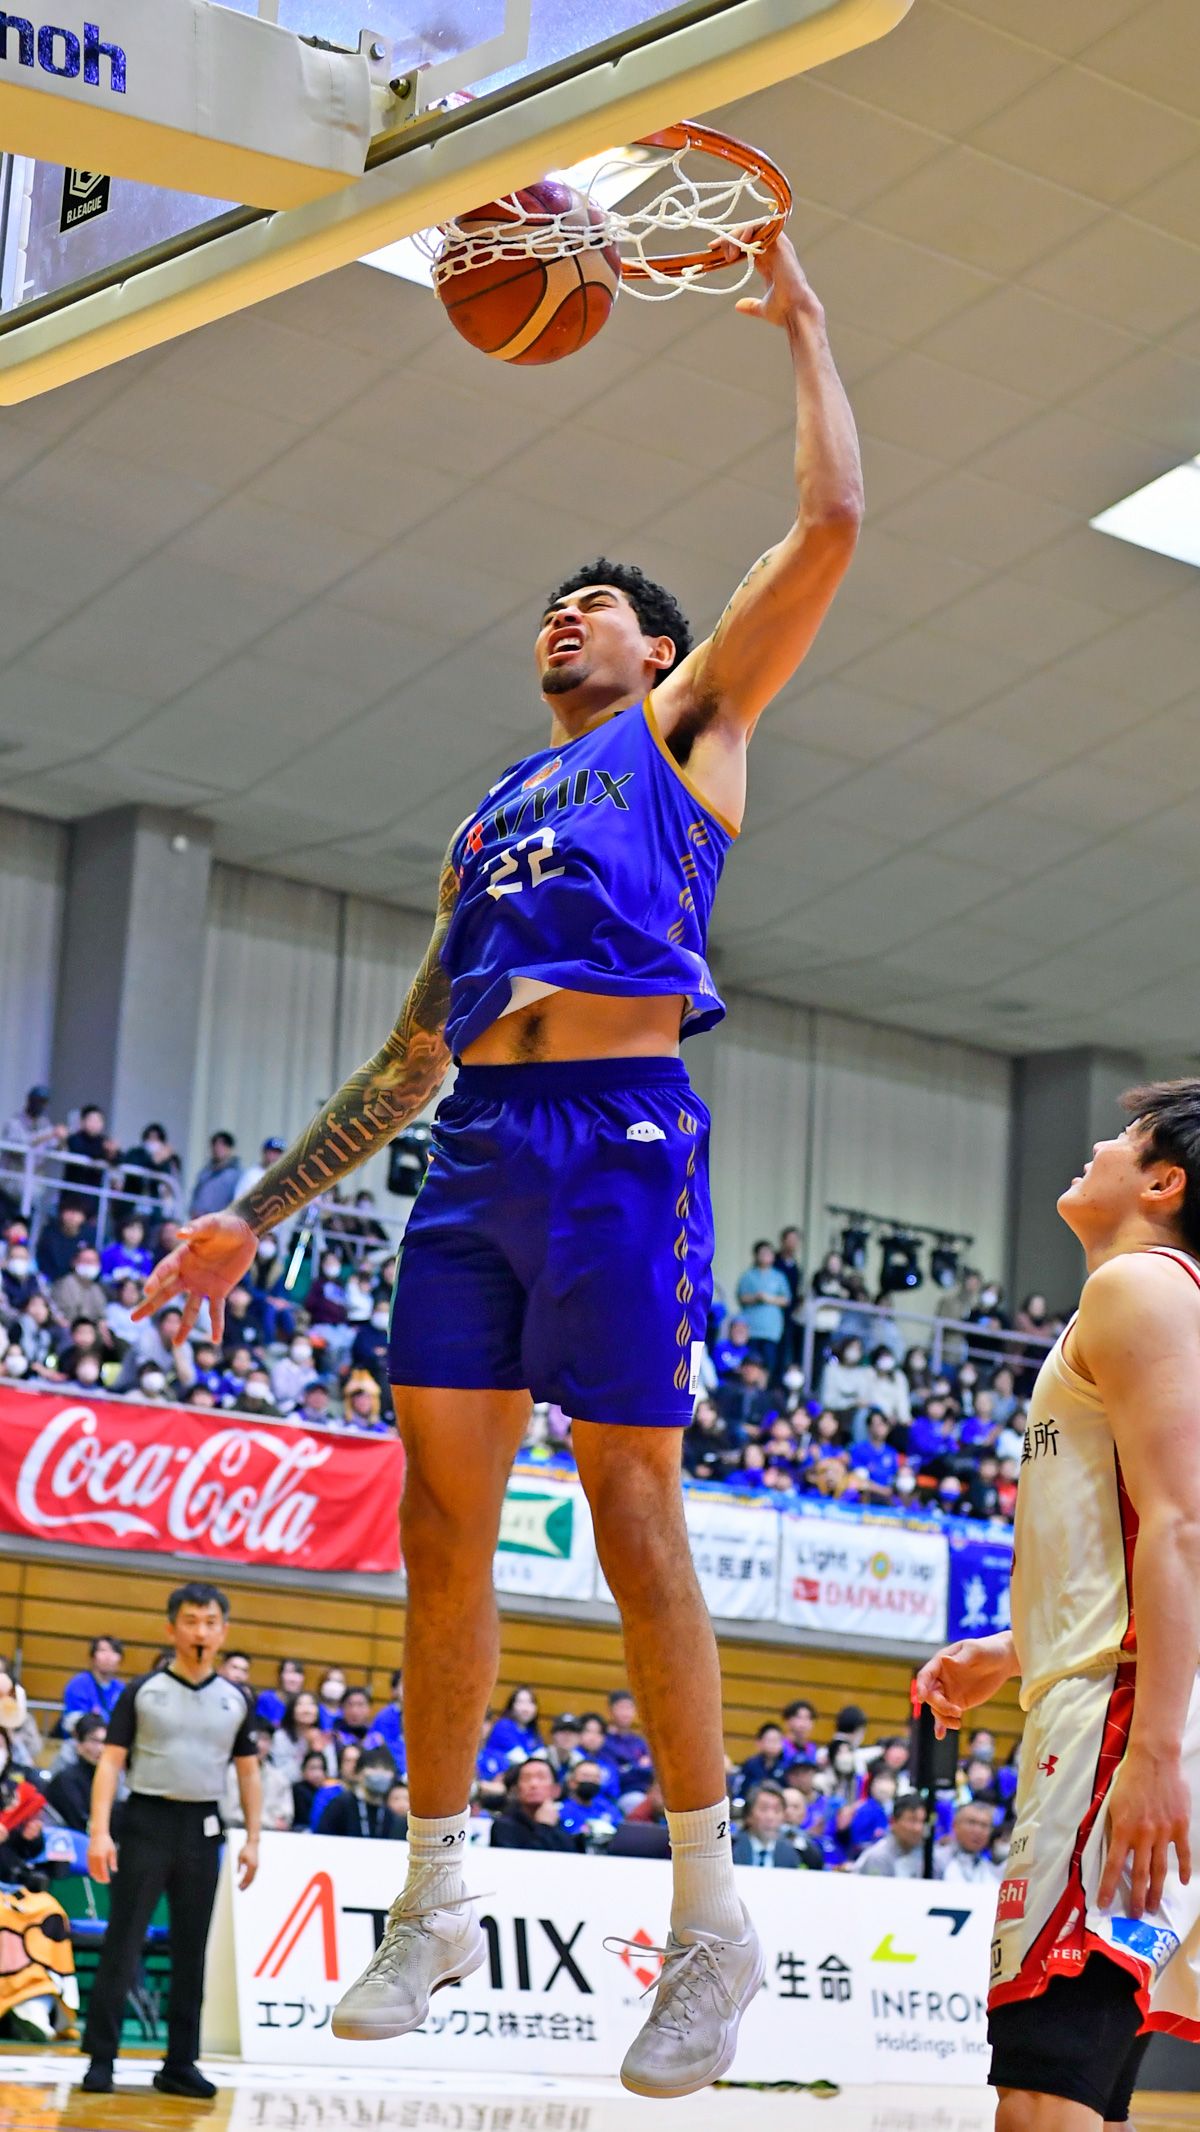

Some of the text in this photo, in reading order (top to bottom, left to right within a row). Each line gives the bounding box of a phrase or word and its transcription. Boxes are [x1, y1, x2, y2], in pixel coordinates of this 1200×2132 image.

[66, 195, 103, 224] B.LEAGUE
[480, 827, 566, 902] 22
[16, 1406, 332, 1554] Coca-Cola
[797, 1542, 847, 1573] Light
[910, 1562, 935, 1581] up
[825, 1580, 938, 1617] DAIHATSU
[762, 1951, 853, 2002] 生命
[875, 2031, 956, 2058] Holdings
